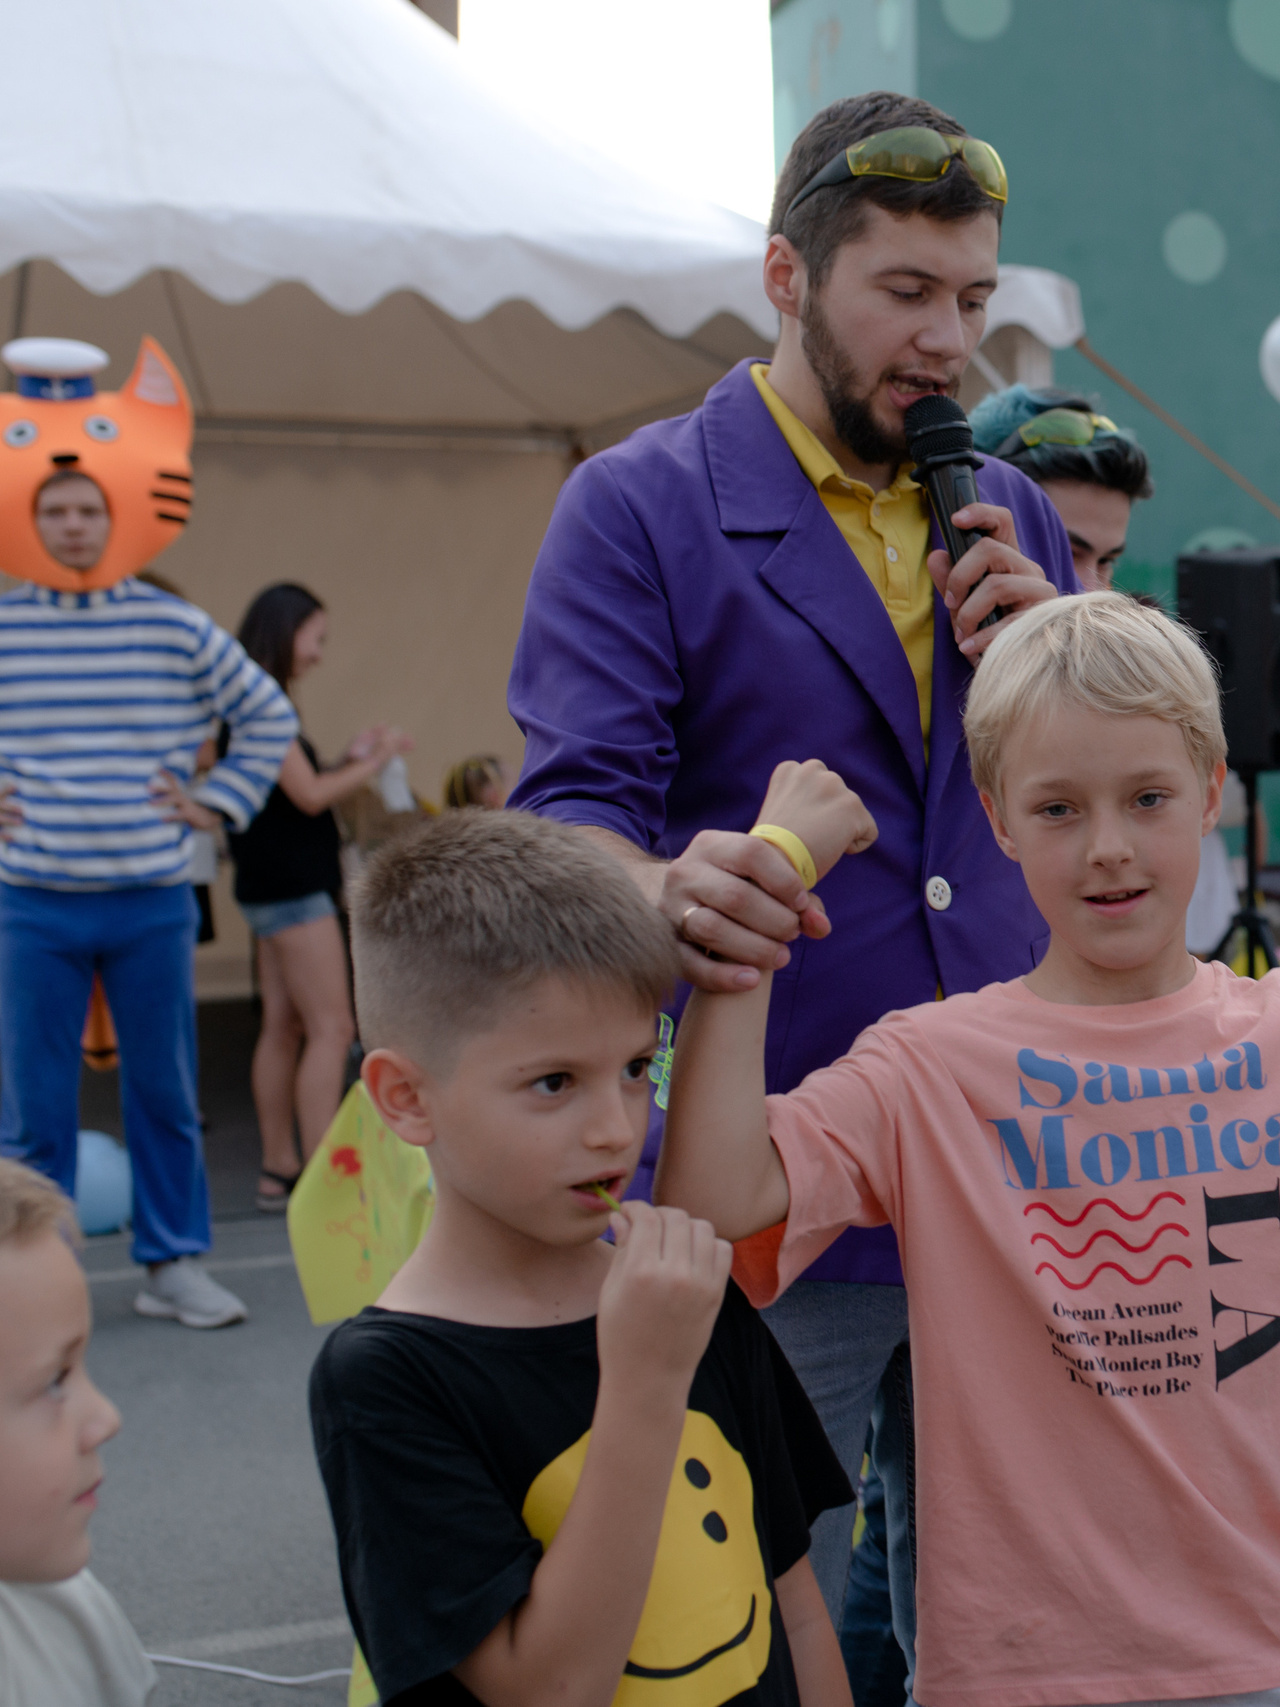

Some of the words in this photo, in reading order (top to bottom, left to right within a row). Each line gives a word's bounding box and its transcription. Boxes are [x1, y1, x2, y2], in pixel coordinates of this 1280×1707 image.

[1016, 1041, 1267, 1110] Santa
[1110, 1300, 1183, 1320] Avenue
[1103, 1324, 1199, 1346] Palisades
[1165, 1351, 1204, 1369] Bay
[1142, 1382, 1161, 1396] to
[1165, 1377, 1191, 1395] Be
